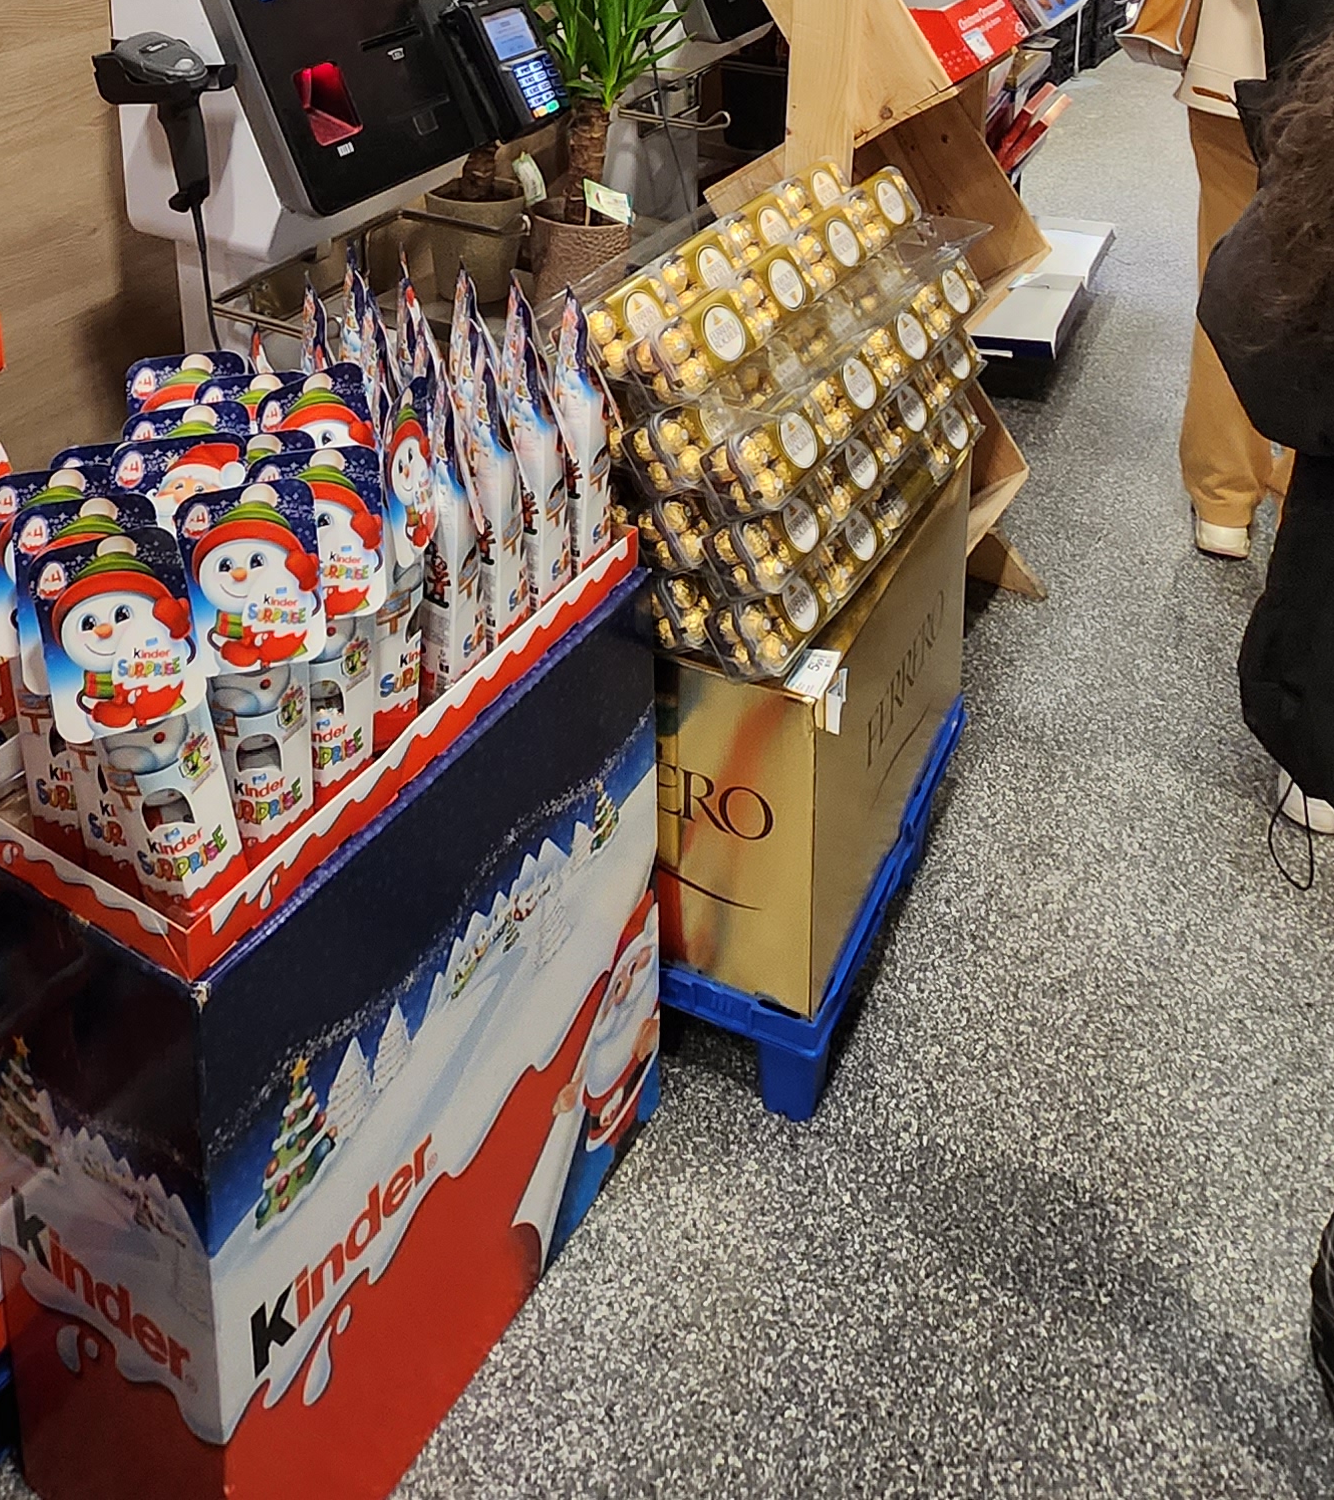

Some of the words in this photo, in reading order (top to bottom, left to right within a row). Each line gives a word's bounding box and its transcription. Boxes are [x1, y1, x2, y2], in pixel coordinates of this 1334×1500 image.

[329, 552, 363, 565] Kinder
[263, 594, 299, 607] Kinder
[247, 603, 306, 624] SURPRISE
[134, 648, 171, 659] Kinder
[117, 656, 181, 679] SURPRISE
[867, 590, 945, 770] FERRERO
[234, 776, 286, 797] Kinder
[137, 823, 228, 882] SURPRISE
[147, 827, 203, 856] Kinder
[249, 1133, 433, 1379] Kinder
[10, 1186, 193, 1383] Kinder
